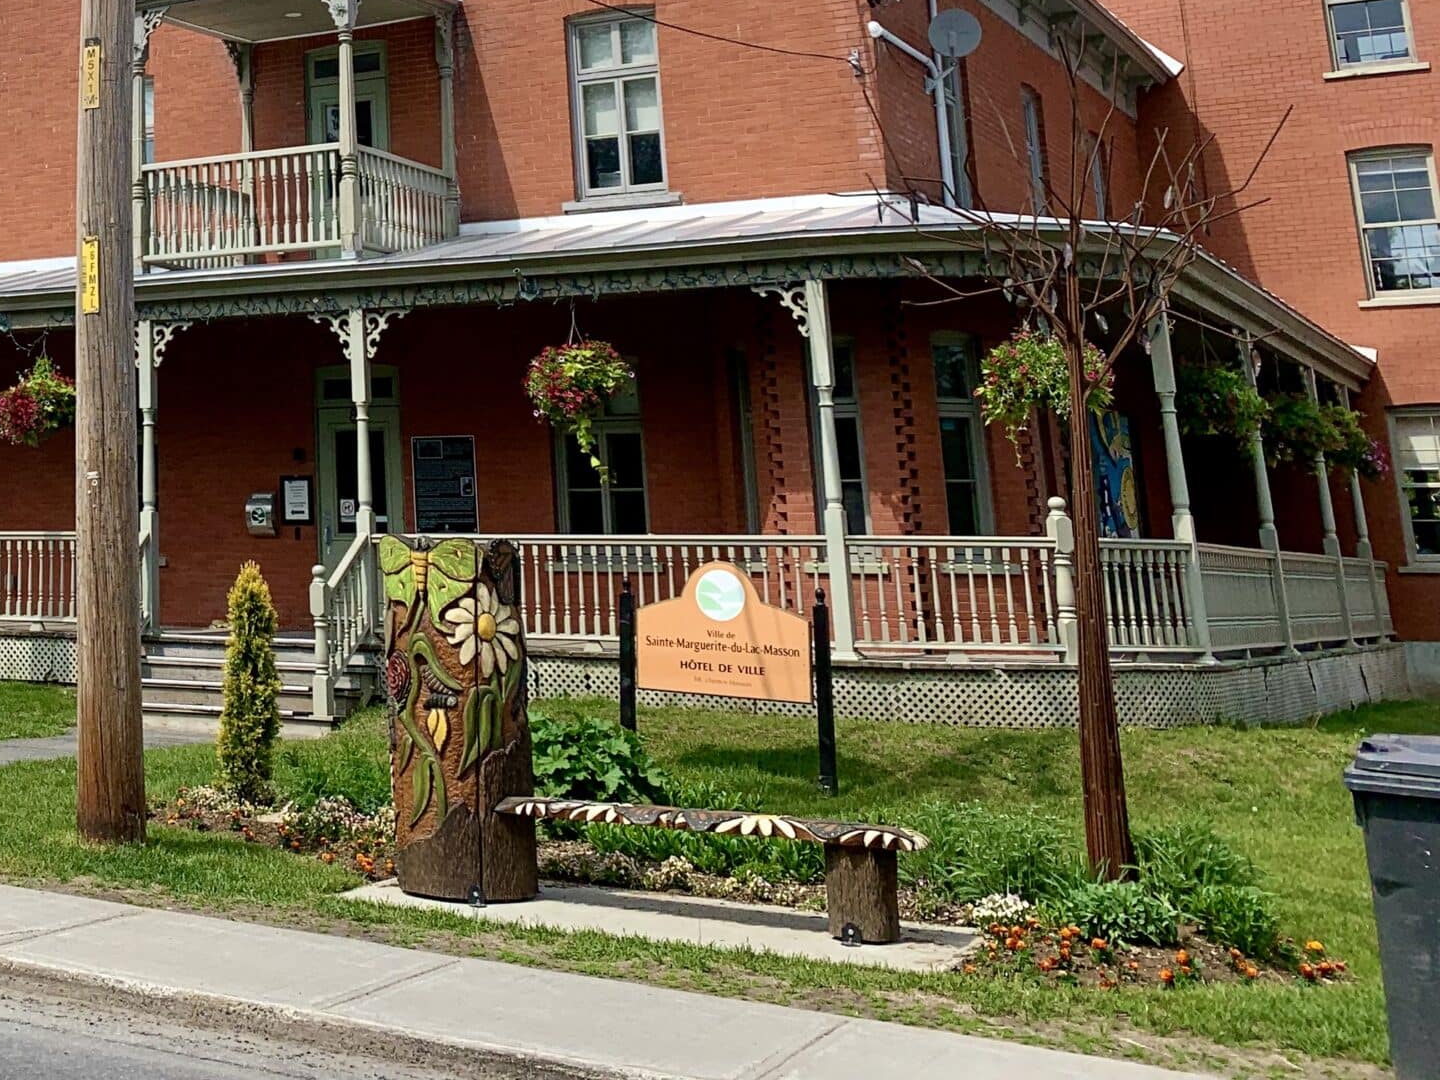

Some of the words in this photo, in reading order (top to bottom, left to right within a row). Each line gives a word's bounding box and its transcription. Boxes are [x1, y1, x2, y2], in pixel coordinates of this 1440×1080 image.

[706, 629, 725, 639] Ville
[646, 635, 800, 658] Sainte-Marguerite-du-Lac-Masson
[680, 659, 713, 672] HÔTEL
[718, 663, 733, 673] DE
[738, 666, 765, 676] VILLE
